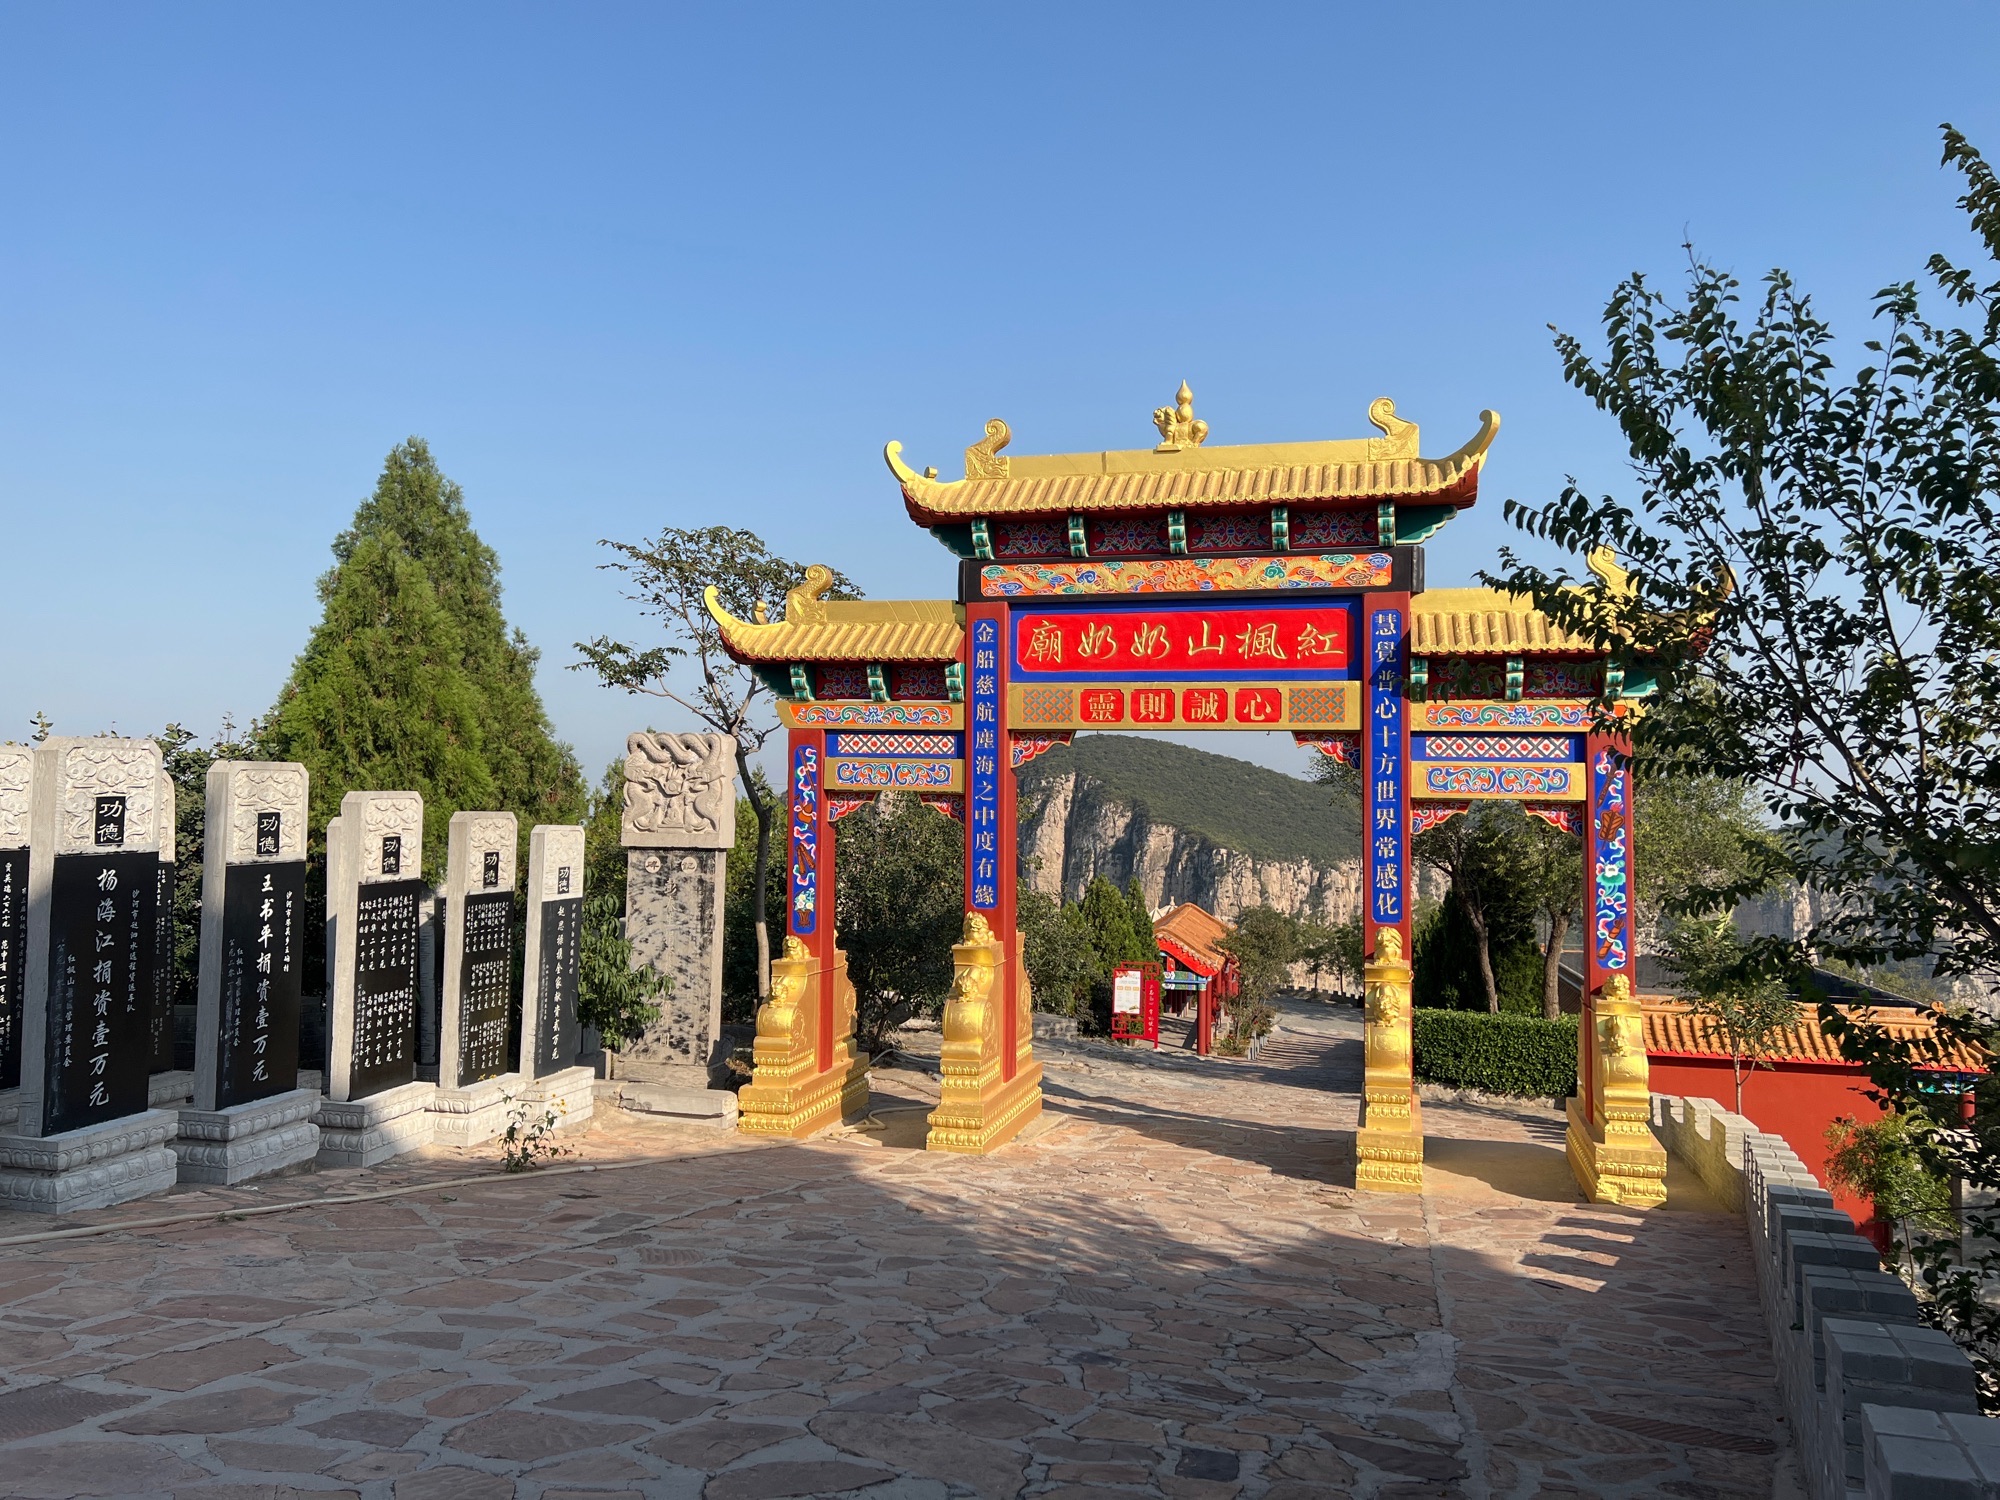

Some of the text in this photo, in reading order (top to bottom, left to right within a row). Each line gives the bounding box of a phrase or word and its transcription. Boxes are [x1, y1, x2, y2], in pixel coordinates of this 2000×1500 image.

[974, 622, 996, 907] 金船慈航塵海之中度有緣
[97, 800, 123, 842] 功德
[259, 817, 279, 854] 功德
[383, 839, 399, 873] 功德
[485, 853, 498, 884] 功德
[558, 867, 570, 893] 功德
[88, 868, 118, 1108] 杨海江捐资壹万元
[252, 873, 275, 1083] 王书平捐资壹万元
